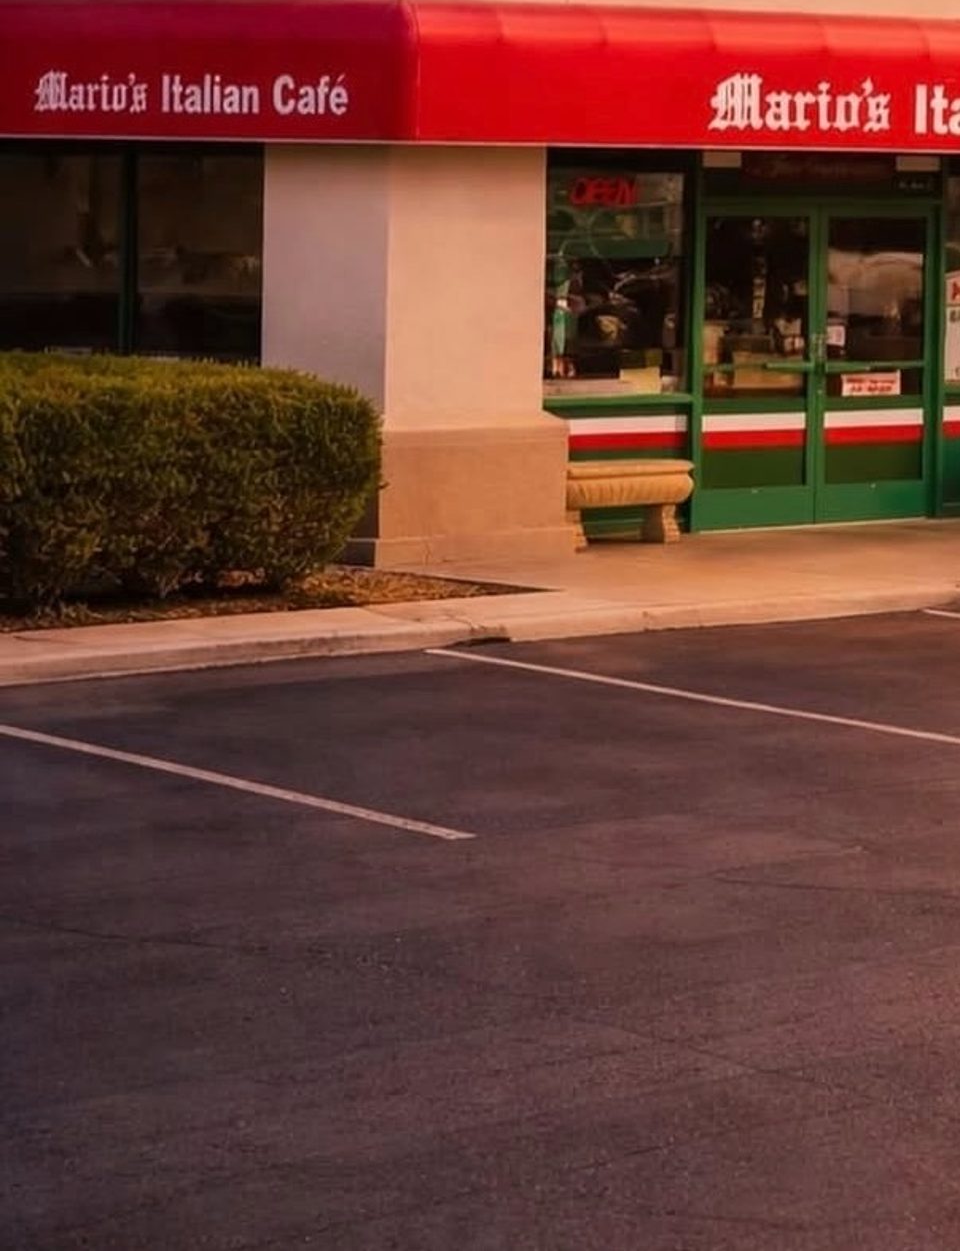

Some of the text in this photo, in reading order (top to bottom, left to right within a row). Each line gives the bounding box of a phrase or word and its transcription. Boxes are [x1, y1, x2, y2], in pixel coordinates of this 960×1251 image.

[35, 70, 348, 115] Mario's Italian Café
[708, 73, 891, 133] Mario's
